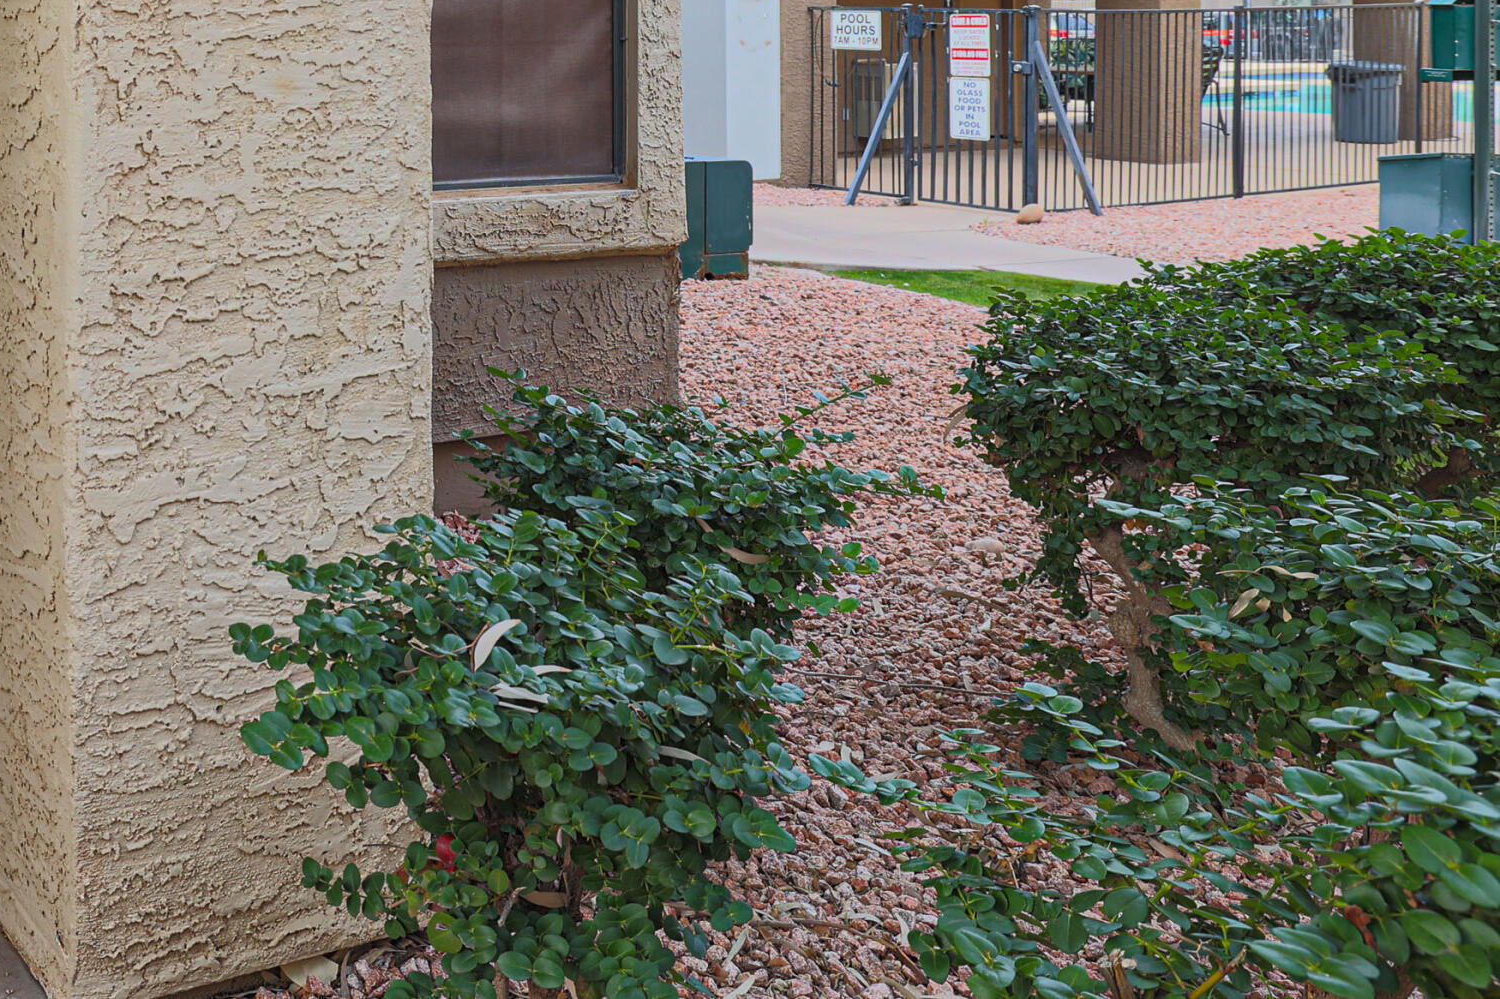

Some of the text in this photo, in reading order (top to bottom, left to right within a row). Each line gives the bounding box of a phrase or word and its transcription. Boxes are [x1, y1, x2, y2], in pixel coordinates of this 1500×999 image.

[840, 13, 871, 24] POOL
[836, 25, 876, 35] HOURS
[834, 36, 850, 44] 7AM
[858, 36, 879, 45] 10PM
[957, 89, 983, 97] GLASS
[967, 105, 986, 113] PETS
[958, 120, 981, 128] POOL
[958, 128, 981, 136] AREA
